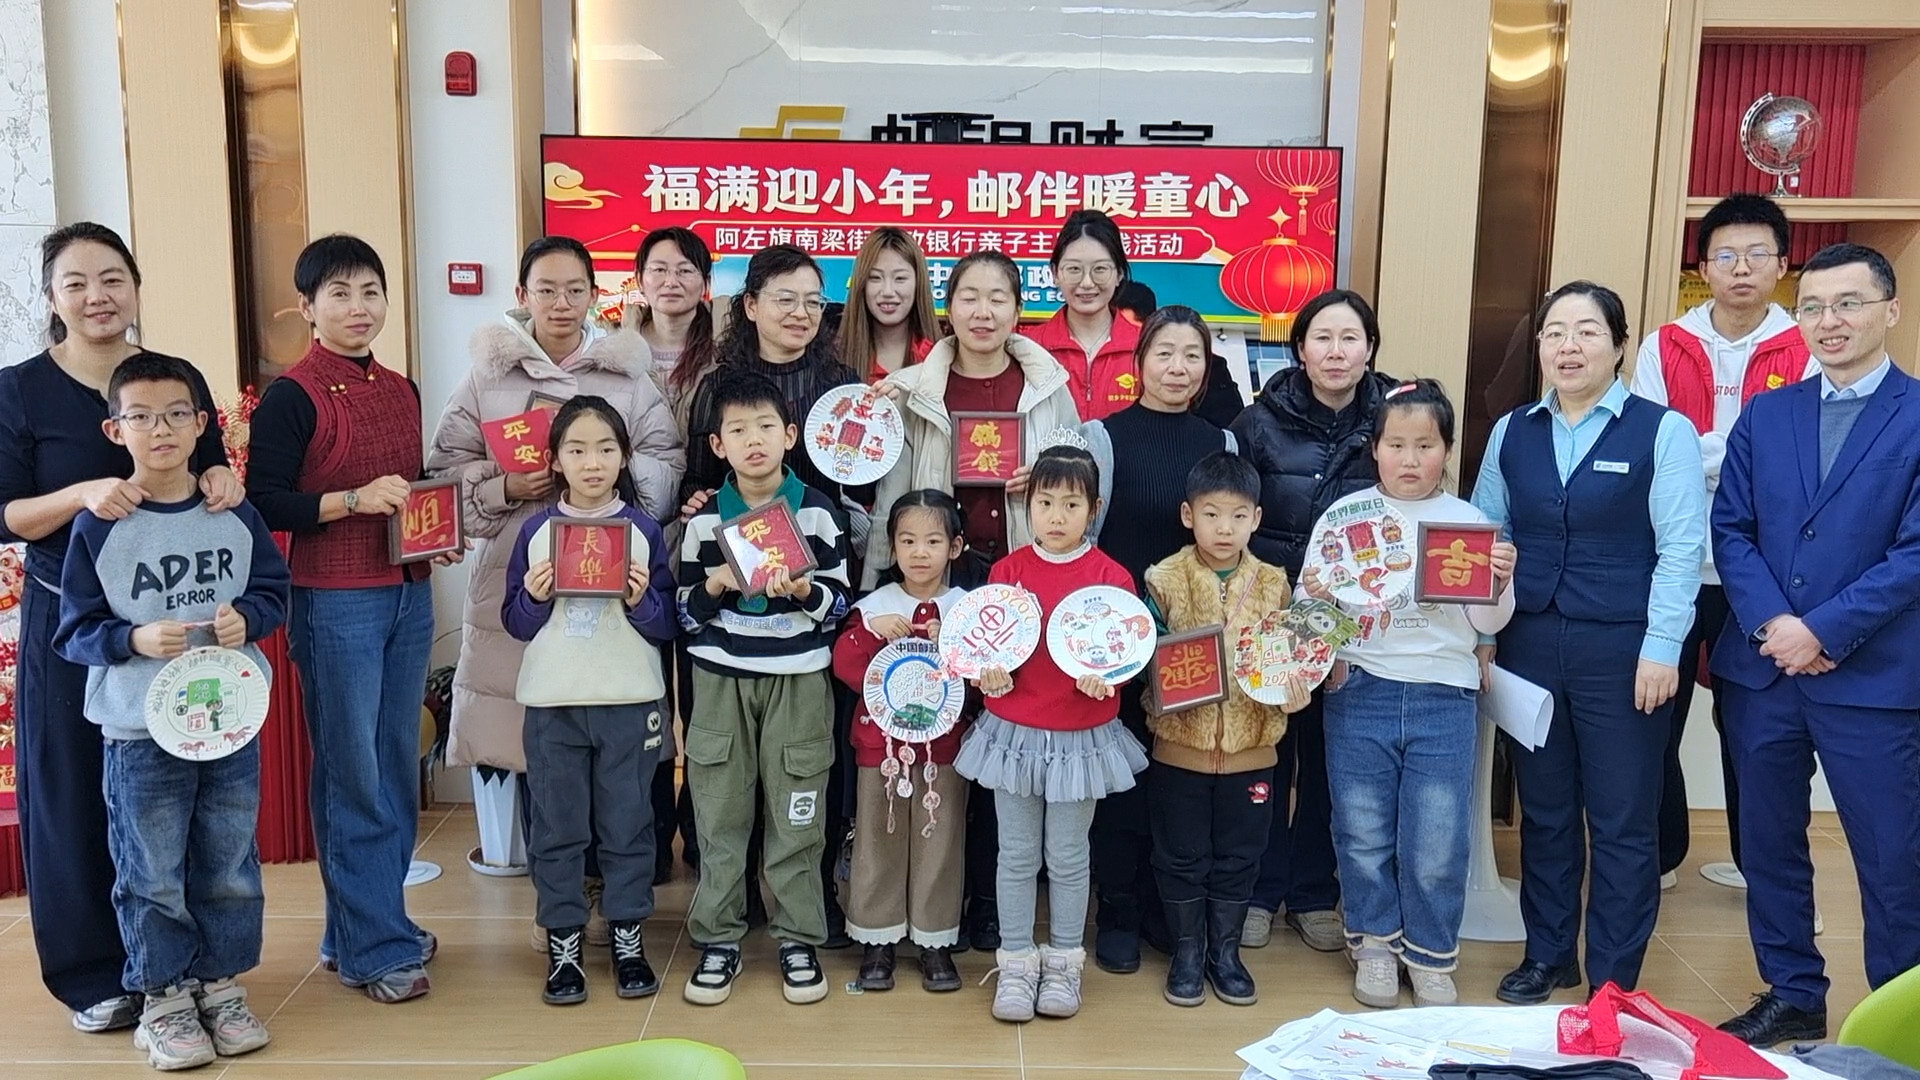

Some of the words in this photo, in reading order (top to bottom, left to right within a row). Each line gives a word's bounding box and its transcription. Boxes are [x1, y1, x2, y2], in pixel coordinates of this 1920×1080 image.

[502, 419, 541, 465] 平安
[1327, 498, 1385, 522] 世界邮政日
[130, 547, 234, 601] ADER
[1426, 538, 1490, 588] 吉
[165, 588, 216, 611] ERROR
[650, 716, 660, 729] W
